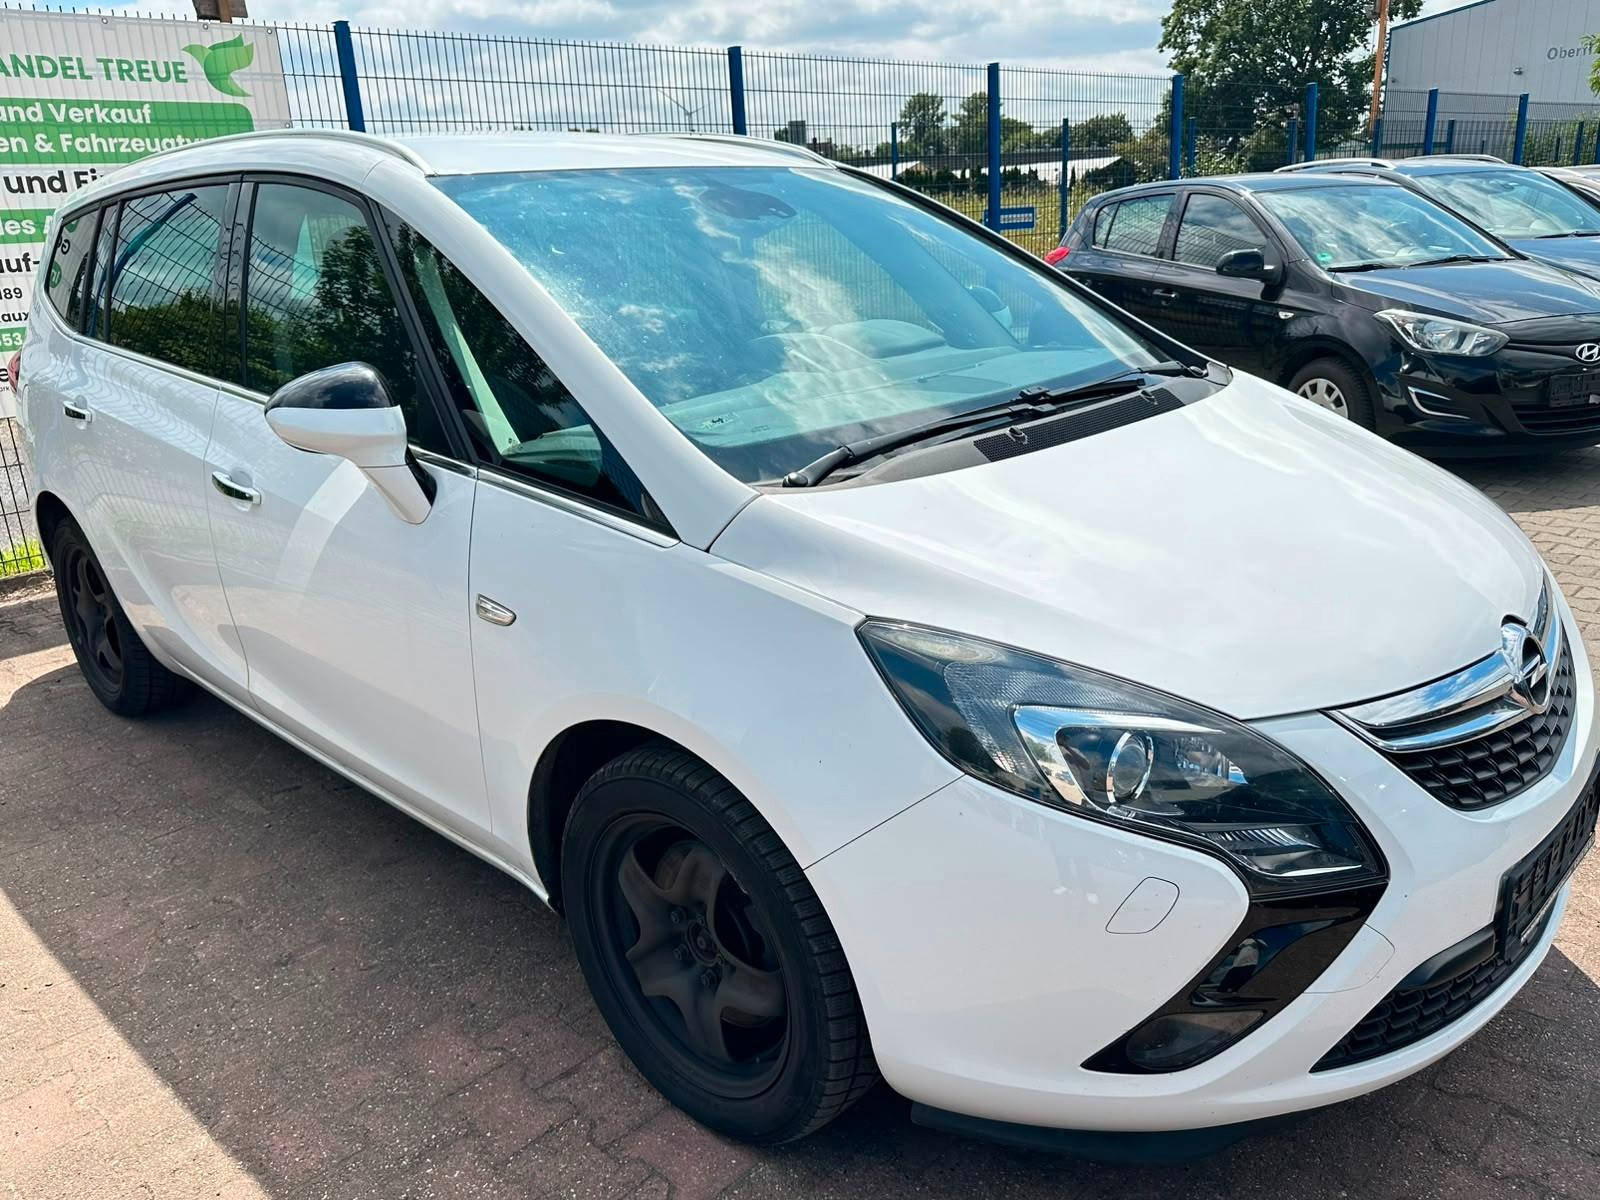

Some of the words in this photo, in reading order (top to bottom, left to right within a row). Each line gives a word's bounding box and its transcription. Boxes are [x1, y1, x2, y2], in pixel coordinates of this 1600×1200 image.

[97, 58, 188, 83] TREUE
[47, 103, 151, 124] Verkauf
[34, 133, 56, 153] &
[3, 170, 67, 193] und
[0, 332, 23, 346] 53
